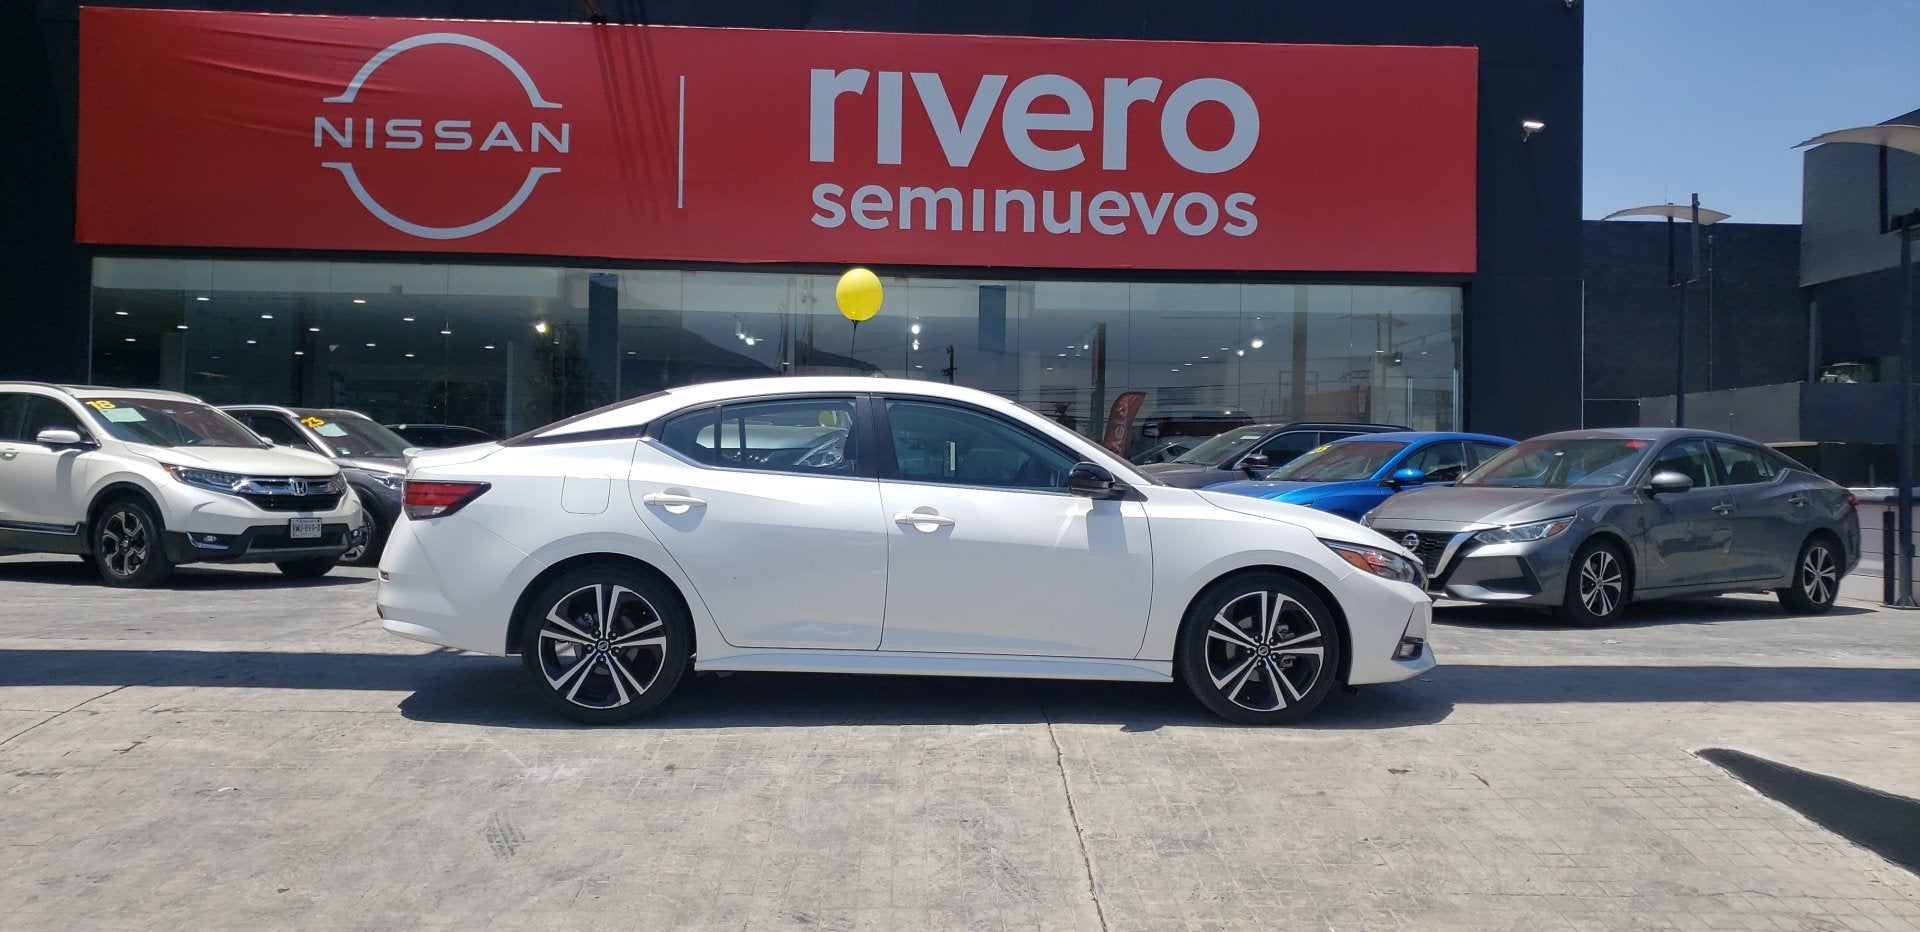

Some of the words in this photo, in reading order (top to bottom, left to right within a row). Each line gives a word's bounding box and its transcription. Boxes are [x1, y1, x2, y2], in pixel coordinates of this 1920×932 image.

[314, 116, 570, 153] NISSAN
[809, 68, 1260, 174] rivero
[810, 183, 1258, 237] seminuevos
[301, 416, 325, 429] 23
